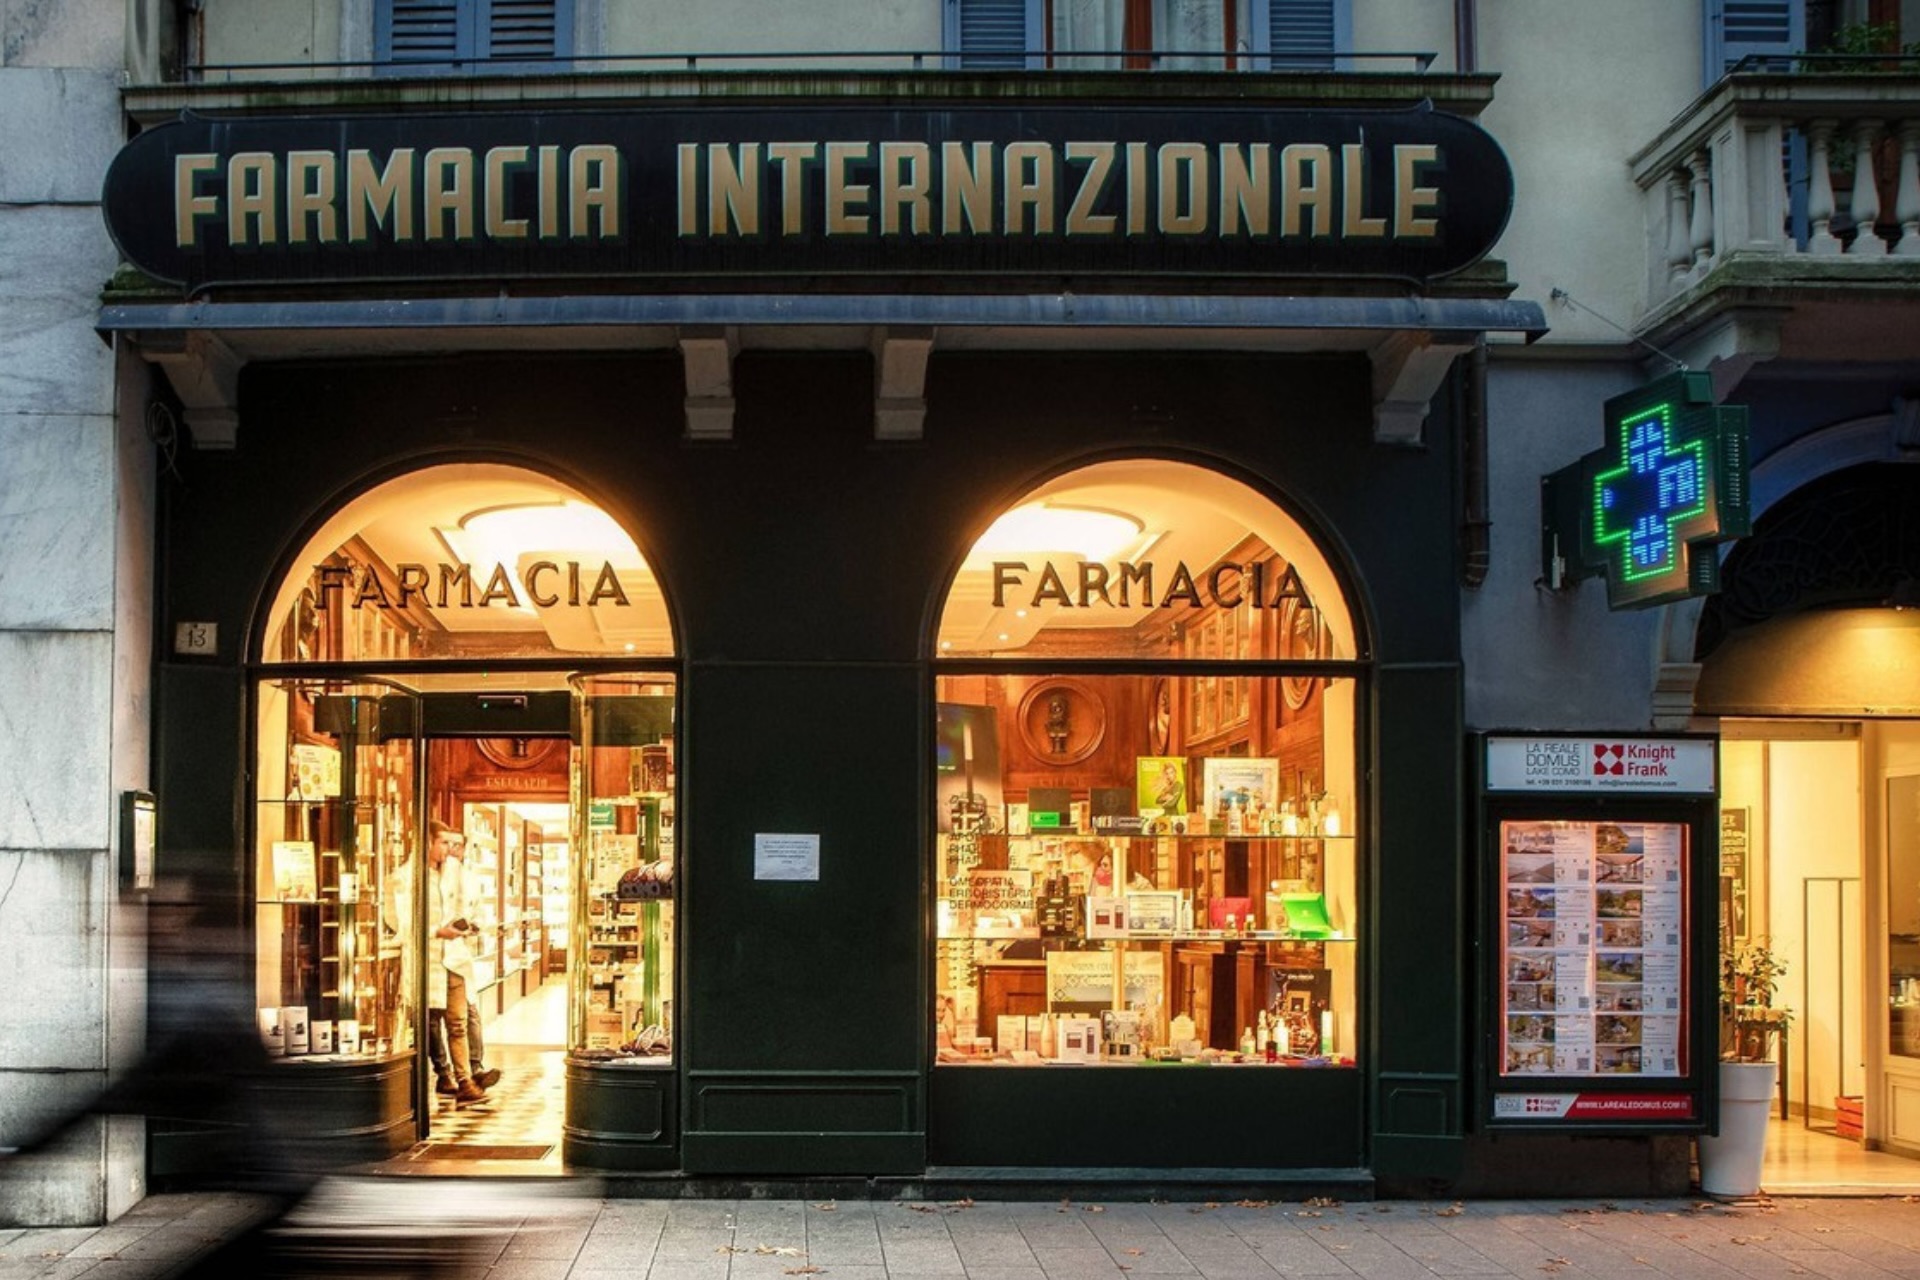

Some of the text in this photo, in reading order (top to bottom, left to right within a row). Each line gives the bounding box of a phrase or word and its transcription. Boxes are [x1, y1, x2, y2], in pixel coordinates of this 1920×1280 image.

[175, 141, 1440, 248] FARMACIA INTERNAZIONALE
[312, 560, 631, 609] FARMACIA
[991, 560, 1315, 609] FARMACIA
[188, 629, 207, 648] 13
[1526, 743, 1580, 753] LA REALE
[1627, 744, 1676, 763] Knight
[1526, 753, 1581, 767] DOMUS
[1526, 767, 1580, 776] LAKE COMO
[1627, 762, 1668, 776] Frank
[949, 876, 1014, 887] OMEOPATIA
